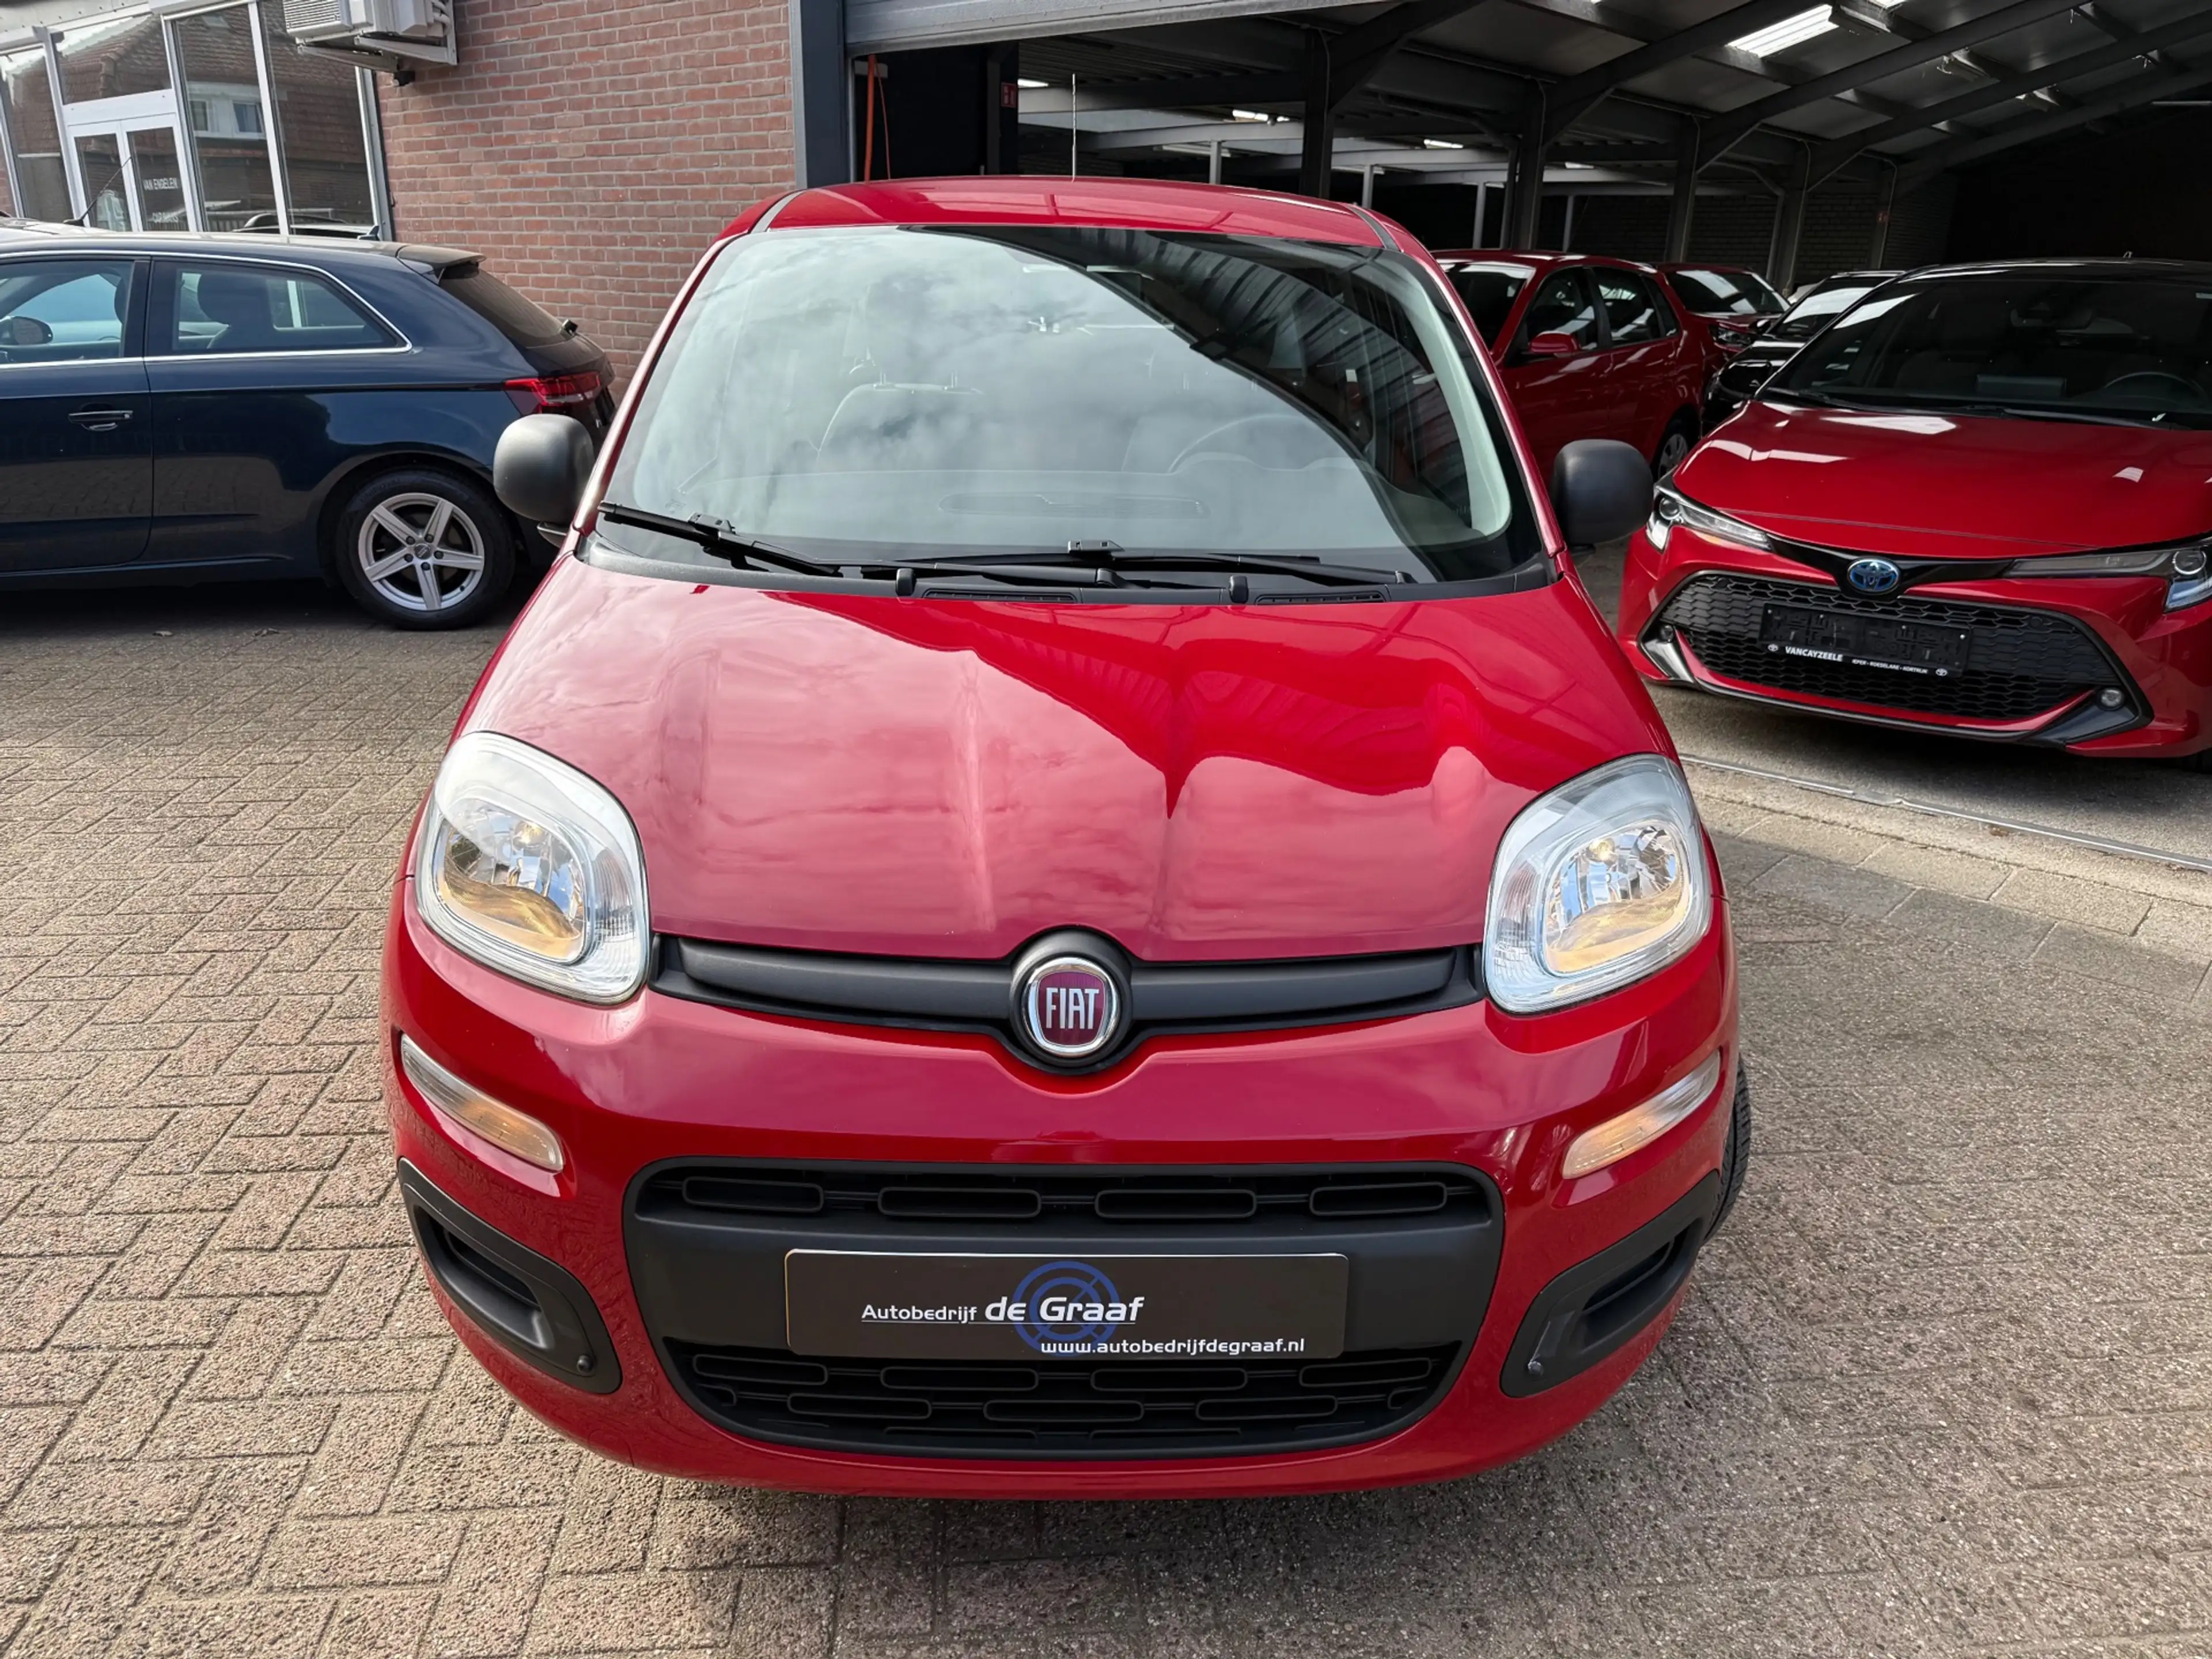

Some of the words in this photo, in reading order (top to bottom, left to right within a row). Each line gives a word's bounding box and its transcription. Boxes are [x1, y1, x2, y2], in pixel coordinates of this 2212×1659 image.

[1785, 646, 1843, 662] VANCAYZEELE
[1046, 987, 1100, 1030] FIAT
[861, 1304, 978, 1324] Autobedrijf
[985, 1296, 1027, 1321] de
[1040, 1297, 1145, 1321] Graaf
[1041, 1338, 1305, 1356] www.autobedrijfdegraaf.nl
